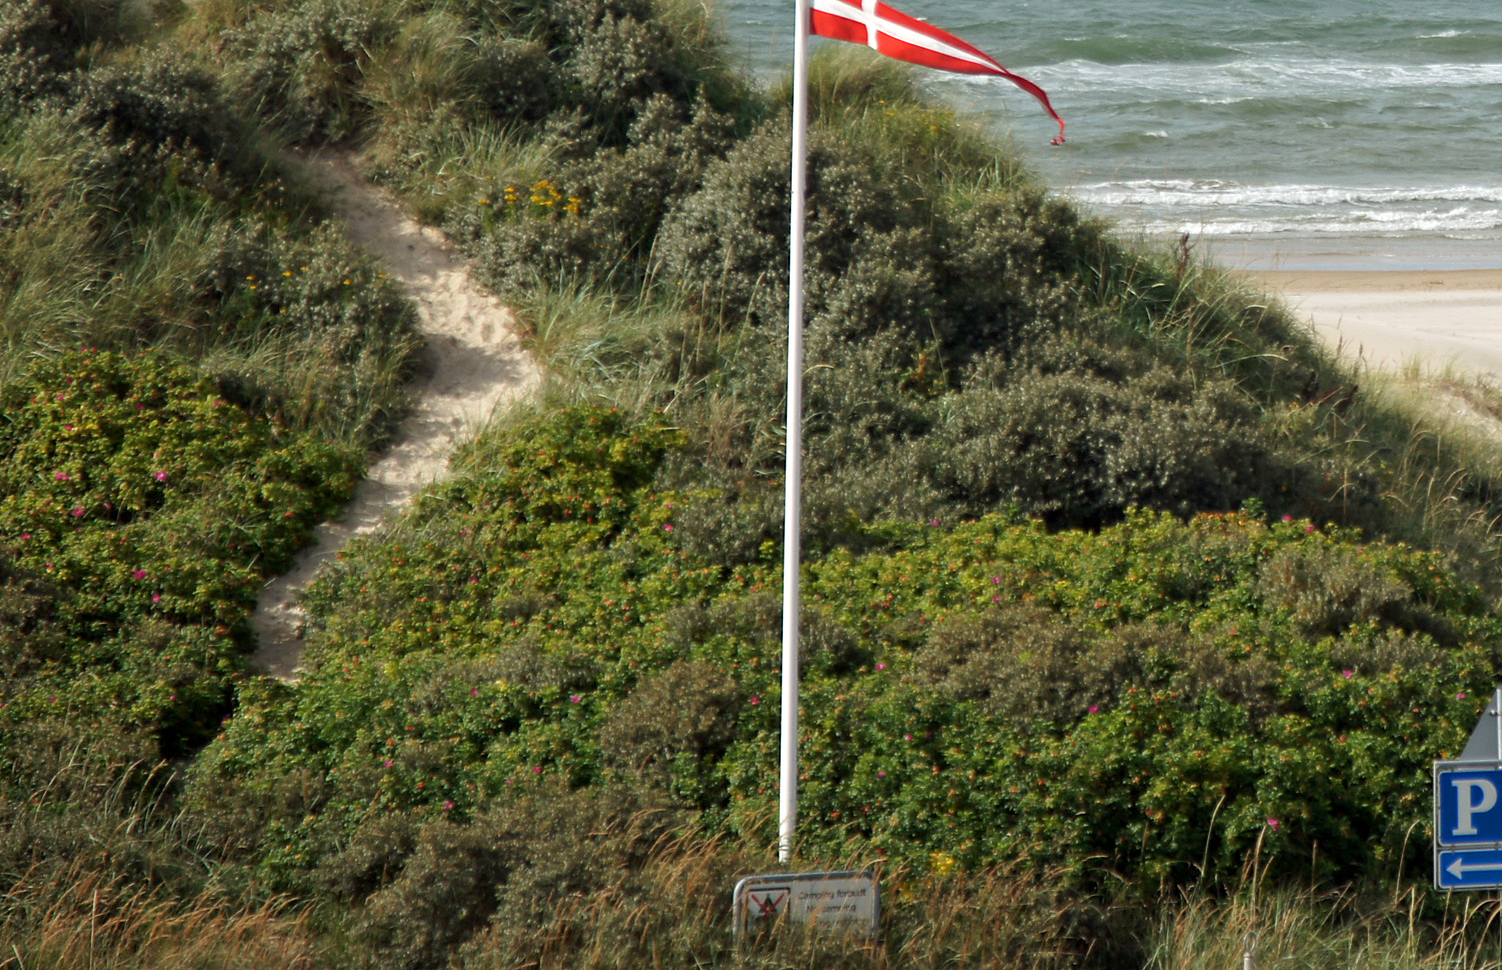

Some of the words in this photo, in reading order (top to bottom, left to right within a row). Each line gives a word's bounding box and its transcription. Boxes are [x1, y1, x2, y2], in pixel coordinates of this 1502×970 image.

[1451, 778, 1498, 837] P
[798, 890, 835, 900] Camping
[836, 888, 867, 898] forbudt
